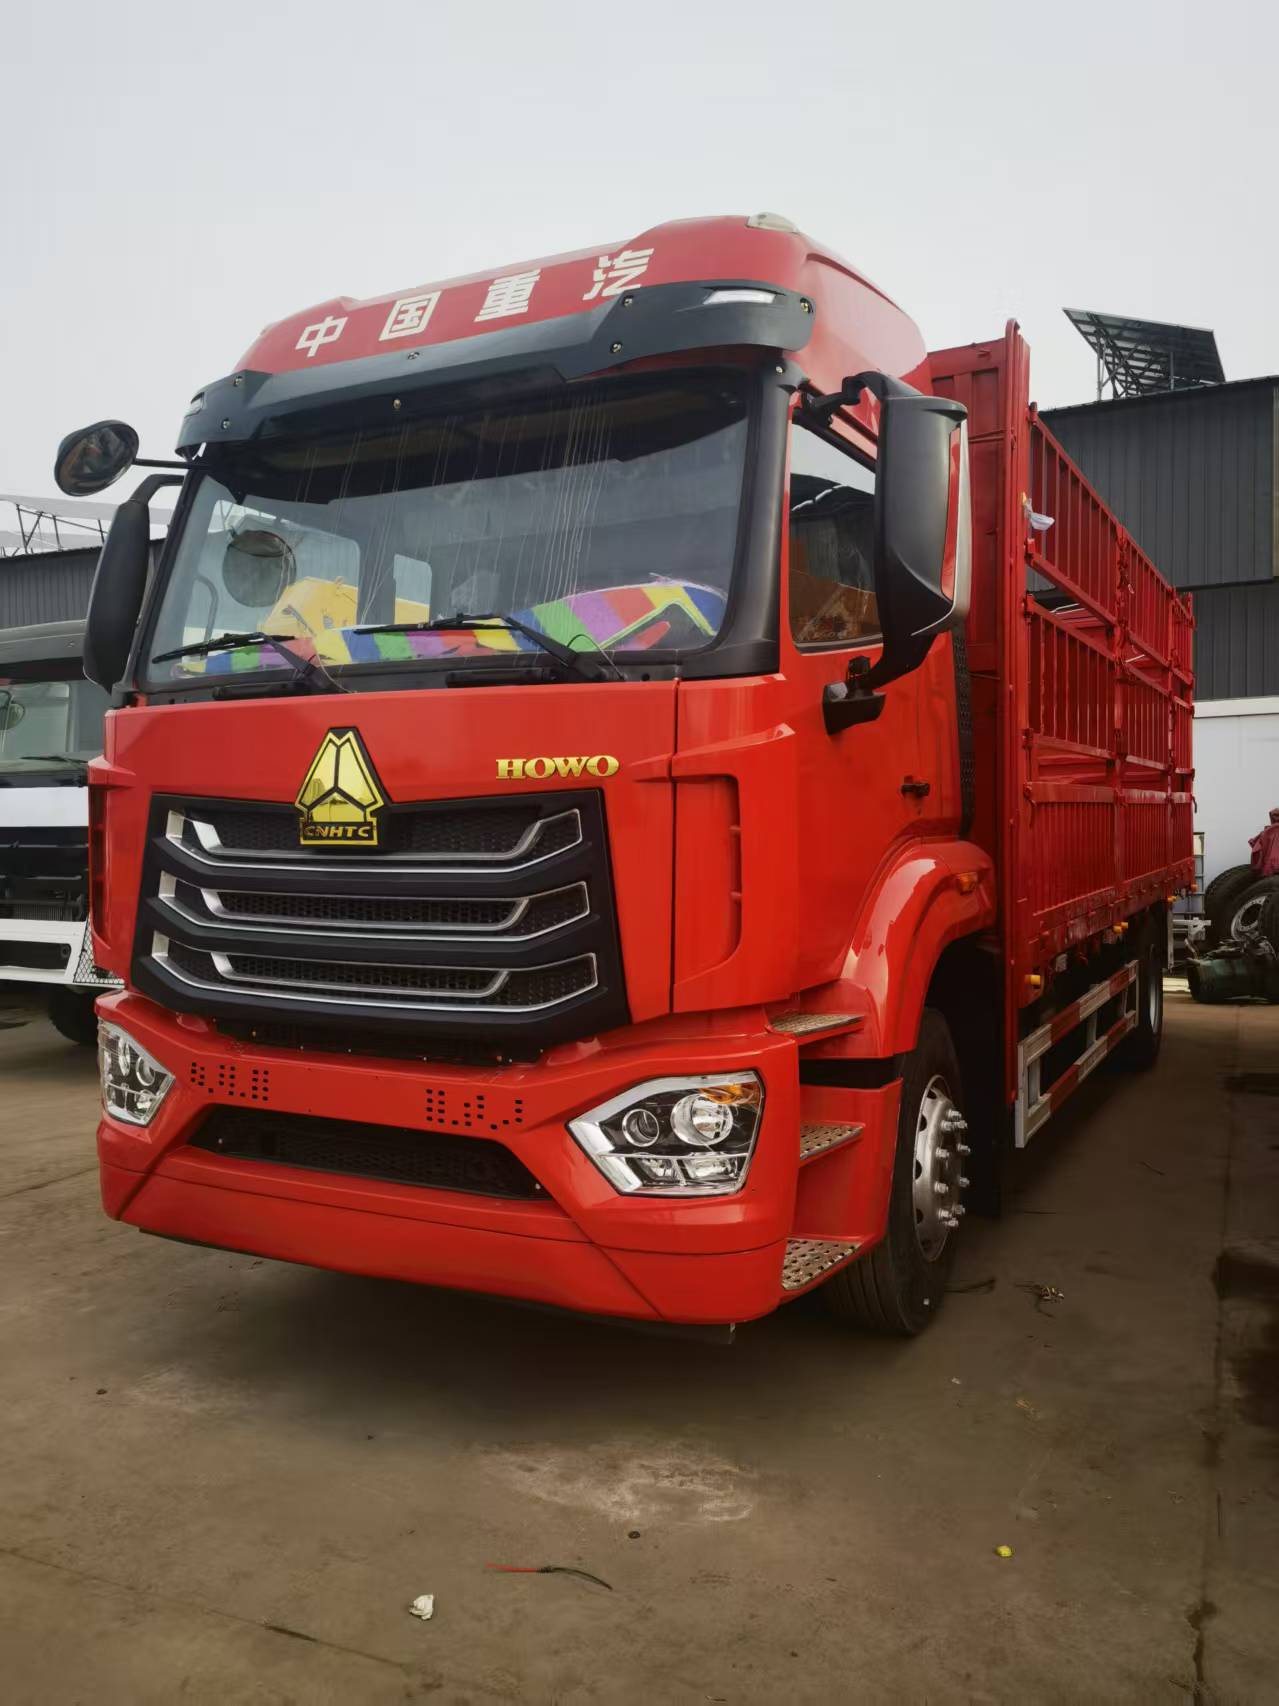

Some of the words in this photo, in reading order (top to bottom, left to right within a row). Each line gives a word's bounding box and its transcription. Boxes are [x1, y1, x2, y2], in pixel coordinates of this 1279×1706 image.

[296, 248, 654, 357] 中国重汽
[496, 755, 619, 779] HOWO
[304, 826, 371, 838] CNHTC
